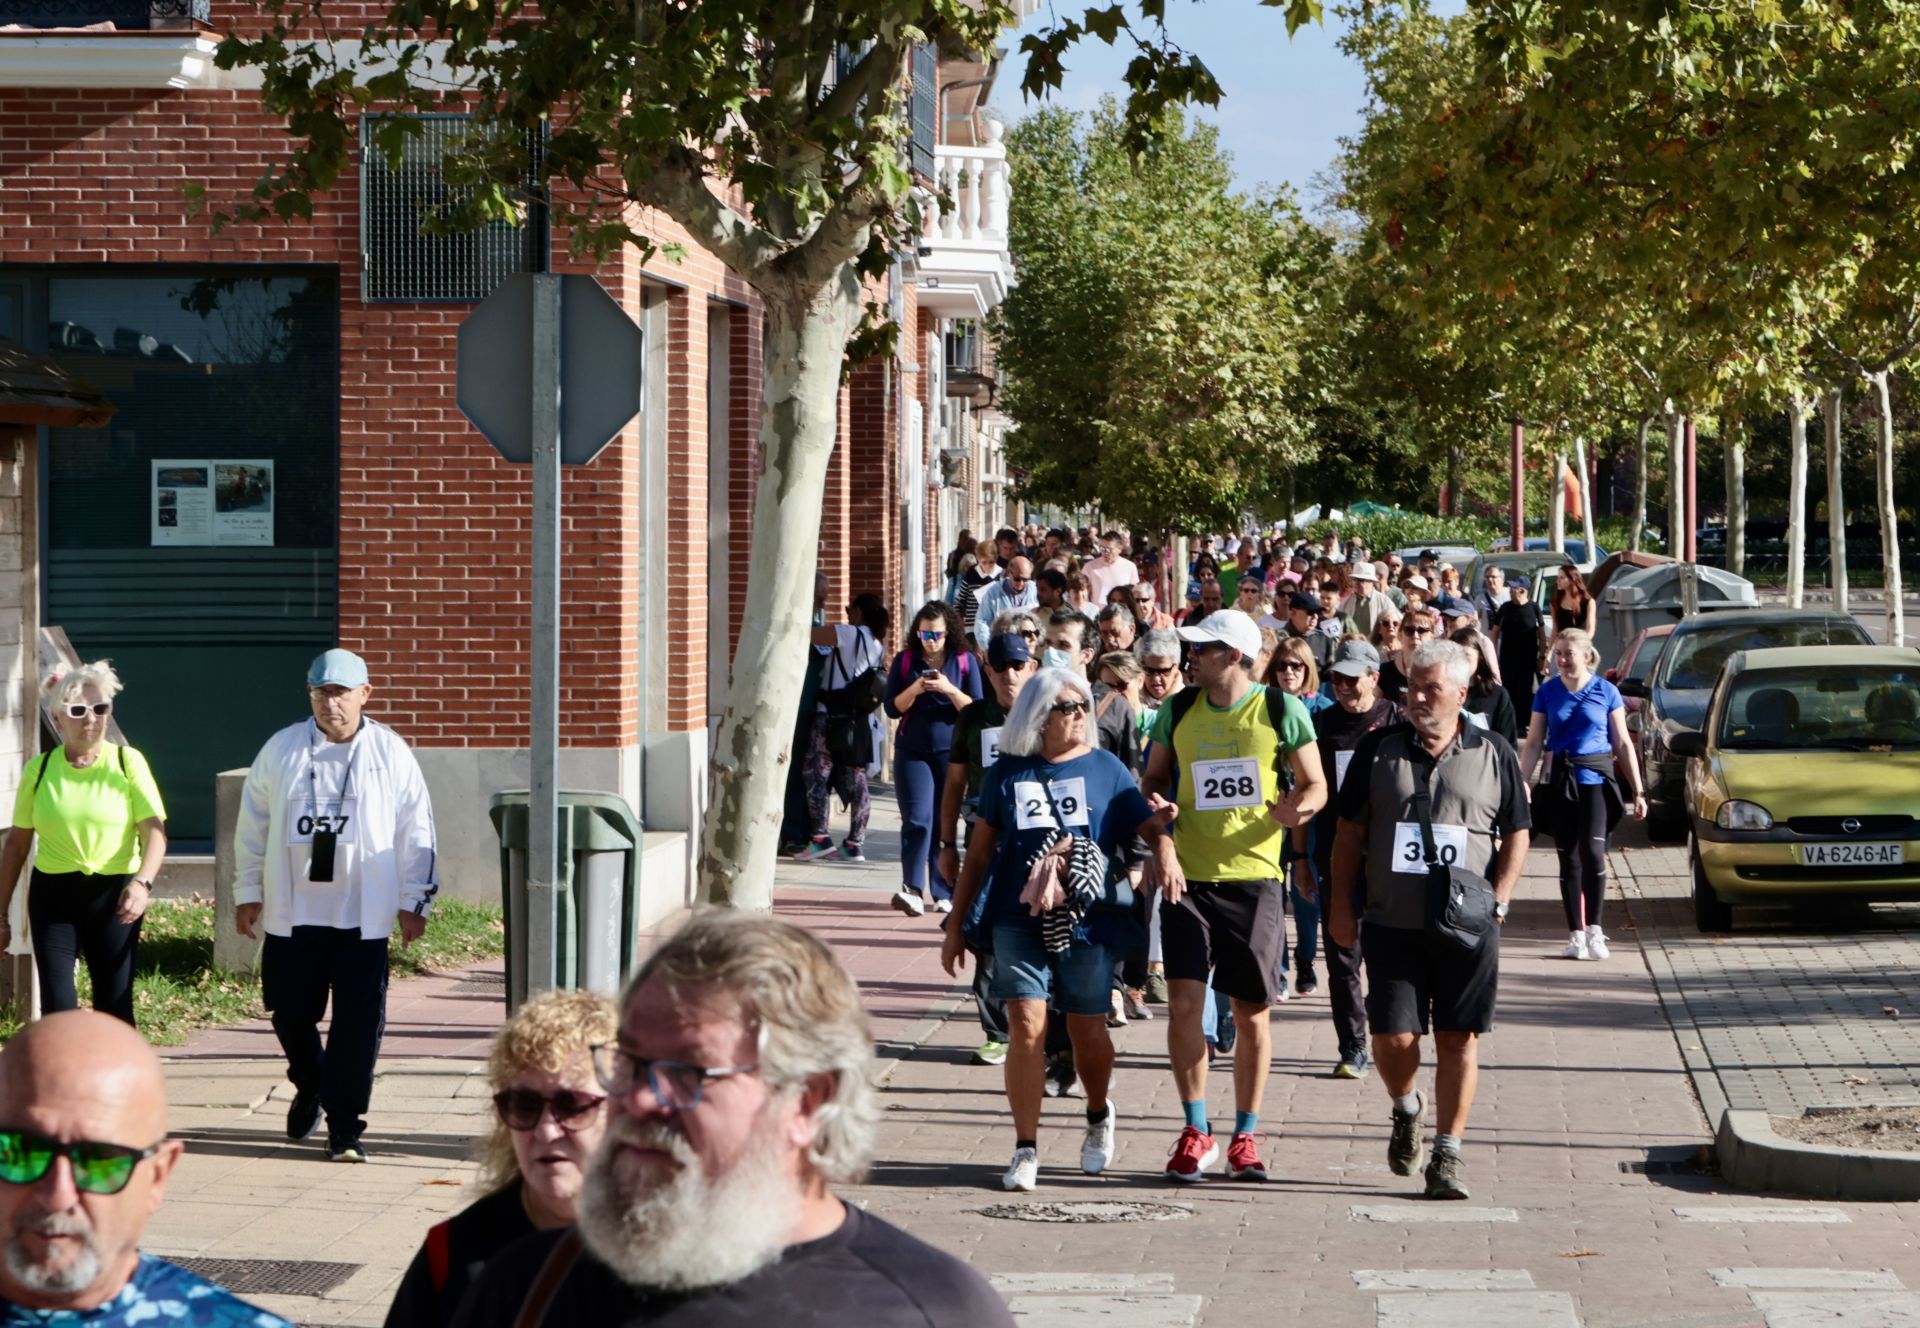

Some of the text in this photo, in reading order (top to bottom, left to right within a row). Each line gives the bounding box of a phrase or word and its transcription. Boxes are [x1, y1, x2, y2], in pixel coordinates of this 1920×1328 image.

[1204, 776, 1254, 799] 268
[297, 815, 349, 835] 057
[1805, 845, 1900, 863] VA-6246-AF
